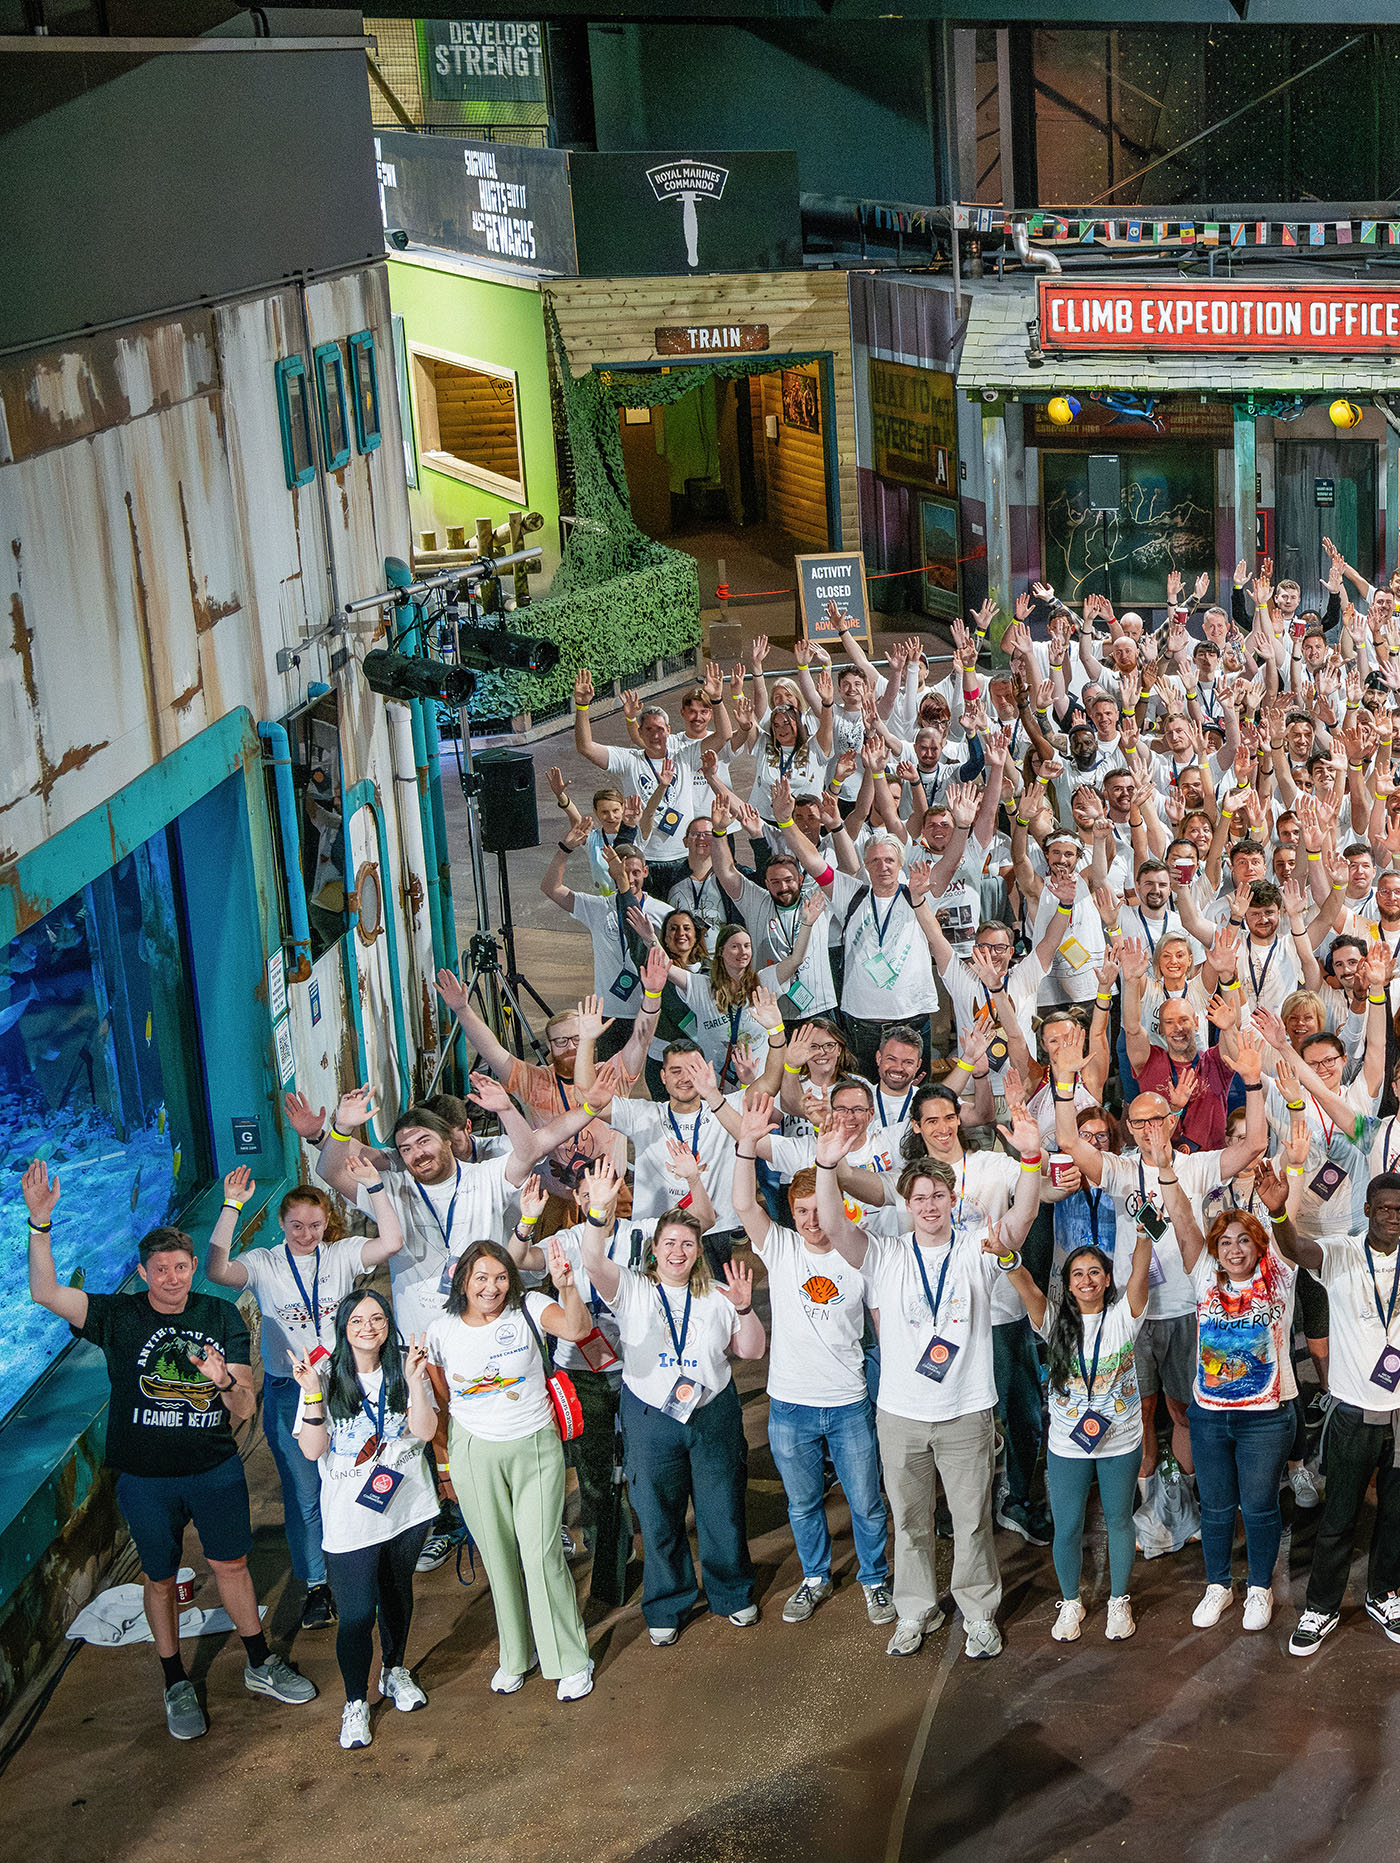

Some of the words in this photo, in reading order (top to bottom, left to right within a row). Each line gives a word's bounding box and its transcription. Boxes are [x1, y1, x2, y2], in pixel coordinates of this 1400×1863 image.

[449, 21, 539, 46] DEVELOPS
[435, 44, 542, 77] STRENGT
[464, 150, 498, 180] SURVIVAL
[654, 169, 682, 184] ROYAL
[683, 168, 721, 183] MARINES
[664, 178, 714, 191] COMMANDO
[478, 179, 508, 214] HURTS
[484, 212, 536, 259] REWARDS
[1051, 298, 1133, 333] CLIMB
[1140, 299, 1301, 336] EXPEDITION
[1309, 302, 1400, 337] OFFICE
[687, 327, 741, 349] TRAIN
[811, 565, 852, 579] ACTIVITY
[816, 585, 851, 599] CLOSED
[815, 618, 861, 631] ADVEURE
[241, 1131, 253, 1144] G
[137, 1327, 177, 1368] ANYTH'G
[133, 1407, 139, 1424] I
[142, 1409, 184, 1428] CANOE
